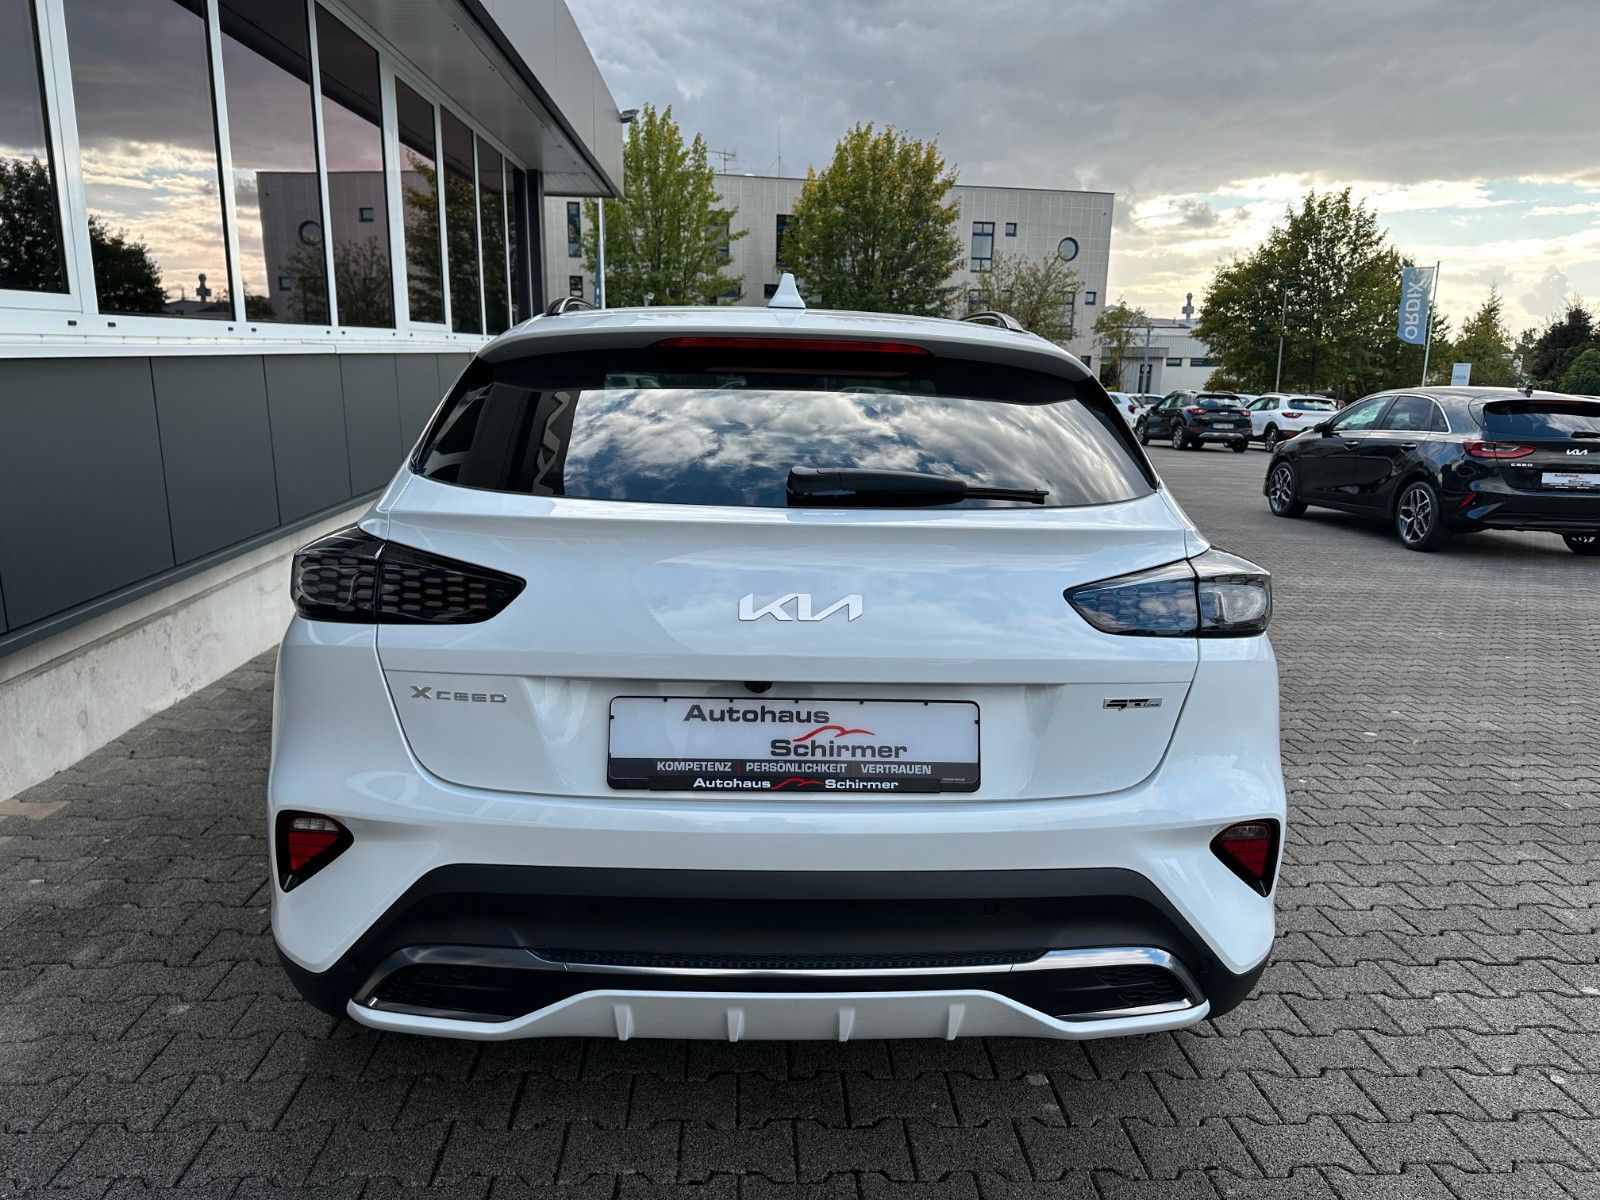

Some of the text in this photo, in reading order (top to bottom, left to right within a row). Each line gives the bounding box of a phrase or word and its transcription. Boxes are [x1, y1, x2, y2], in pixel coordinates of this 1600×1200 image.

[1566, 448, 1588, 456] KIA
[738, 592, 863, 622] KIA
[683, 704, 830, 723] Autohaus
[770, 739, 908, 758] Schirmer
[656, 760, 932, 775] KOMPETENZ PERSÖNLICHKEIT VERTRAUEN
[693, 777, 899, 789] Autohaus Schirmer
